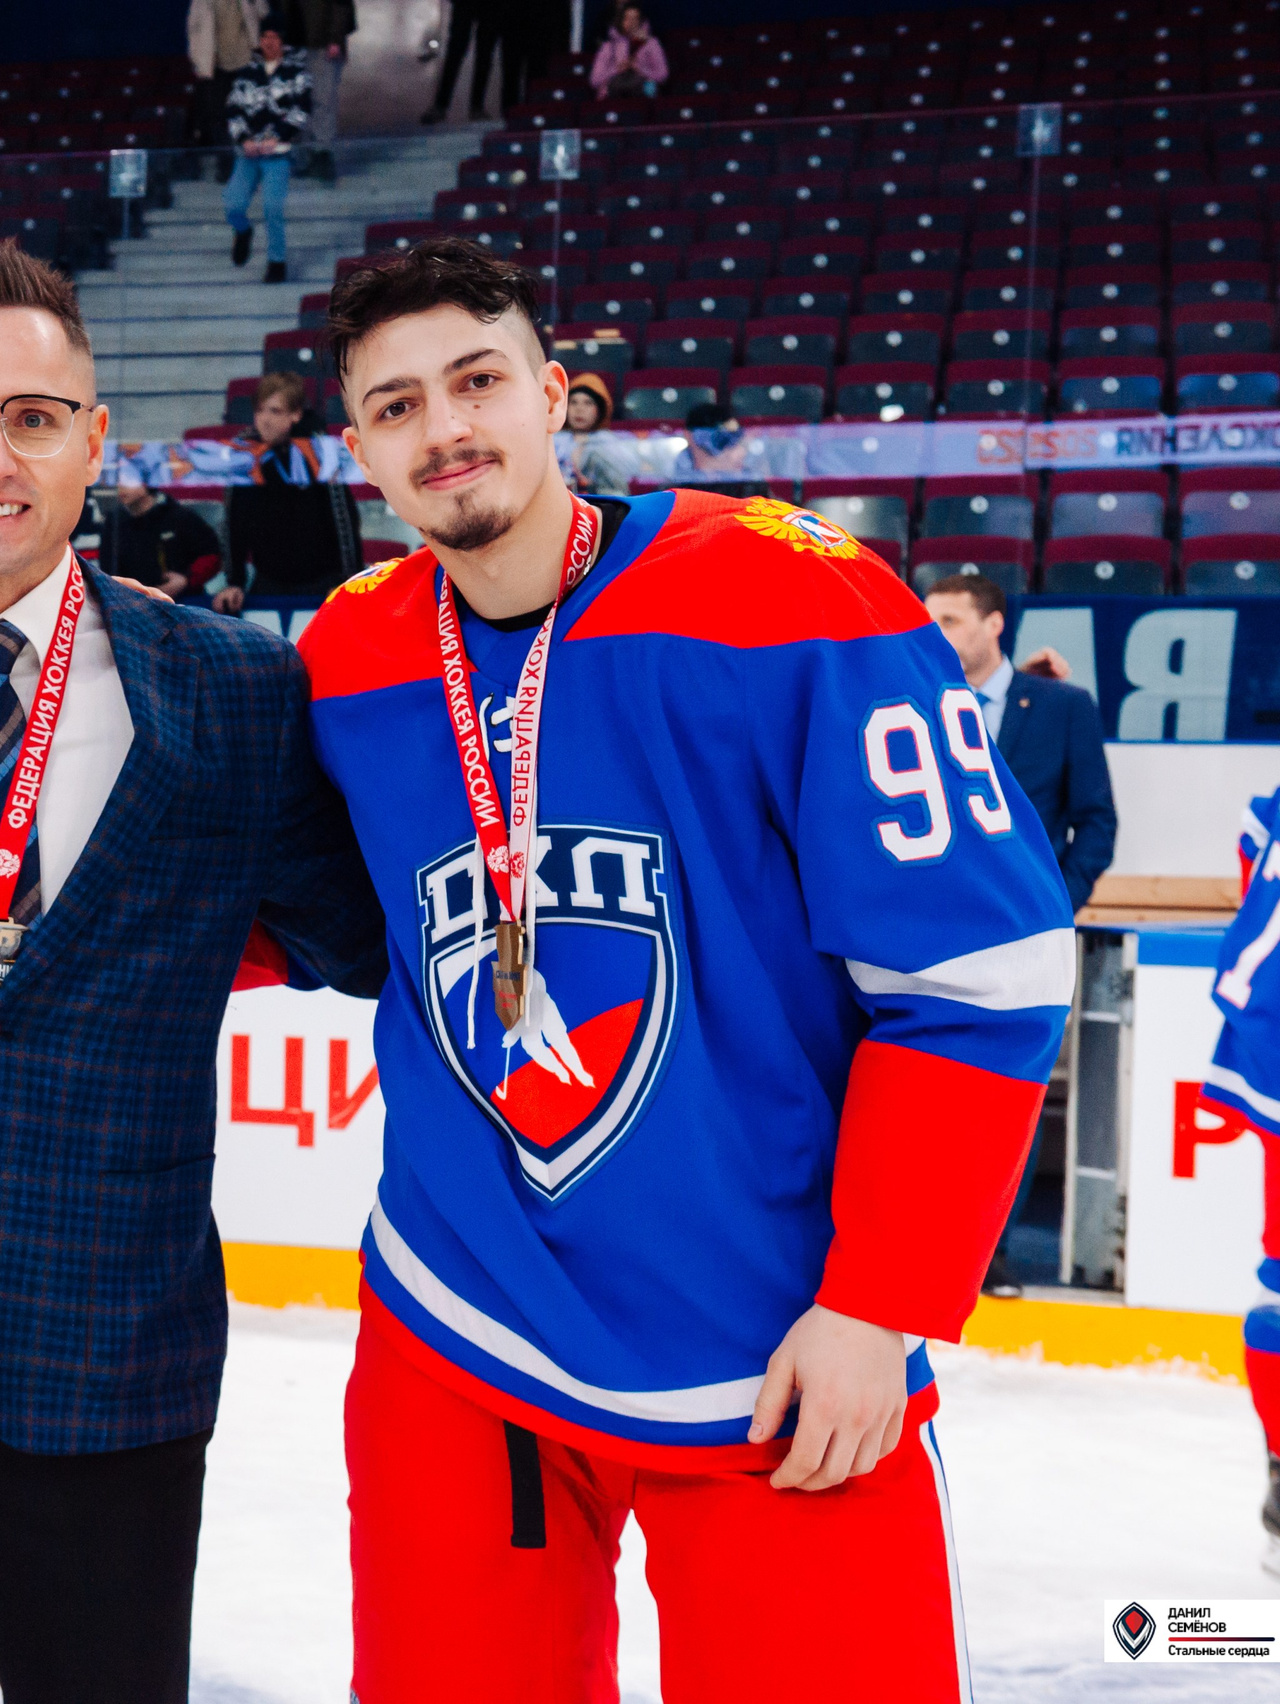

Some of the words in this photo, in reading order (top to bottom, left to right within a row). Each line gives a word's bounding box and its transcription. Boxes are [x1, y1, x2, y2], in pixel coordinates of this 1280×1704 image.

[7, 695, 58, 829] ФЕДЕРАЦИЯ
[42, 615, 74, 701] ХОККЕЯ
[442, 652, 477, 737] ХОККЕЯ
[461, 734, 501, 828] РОССИИ
[863, 687, 1012, 862] 99
